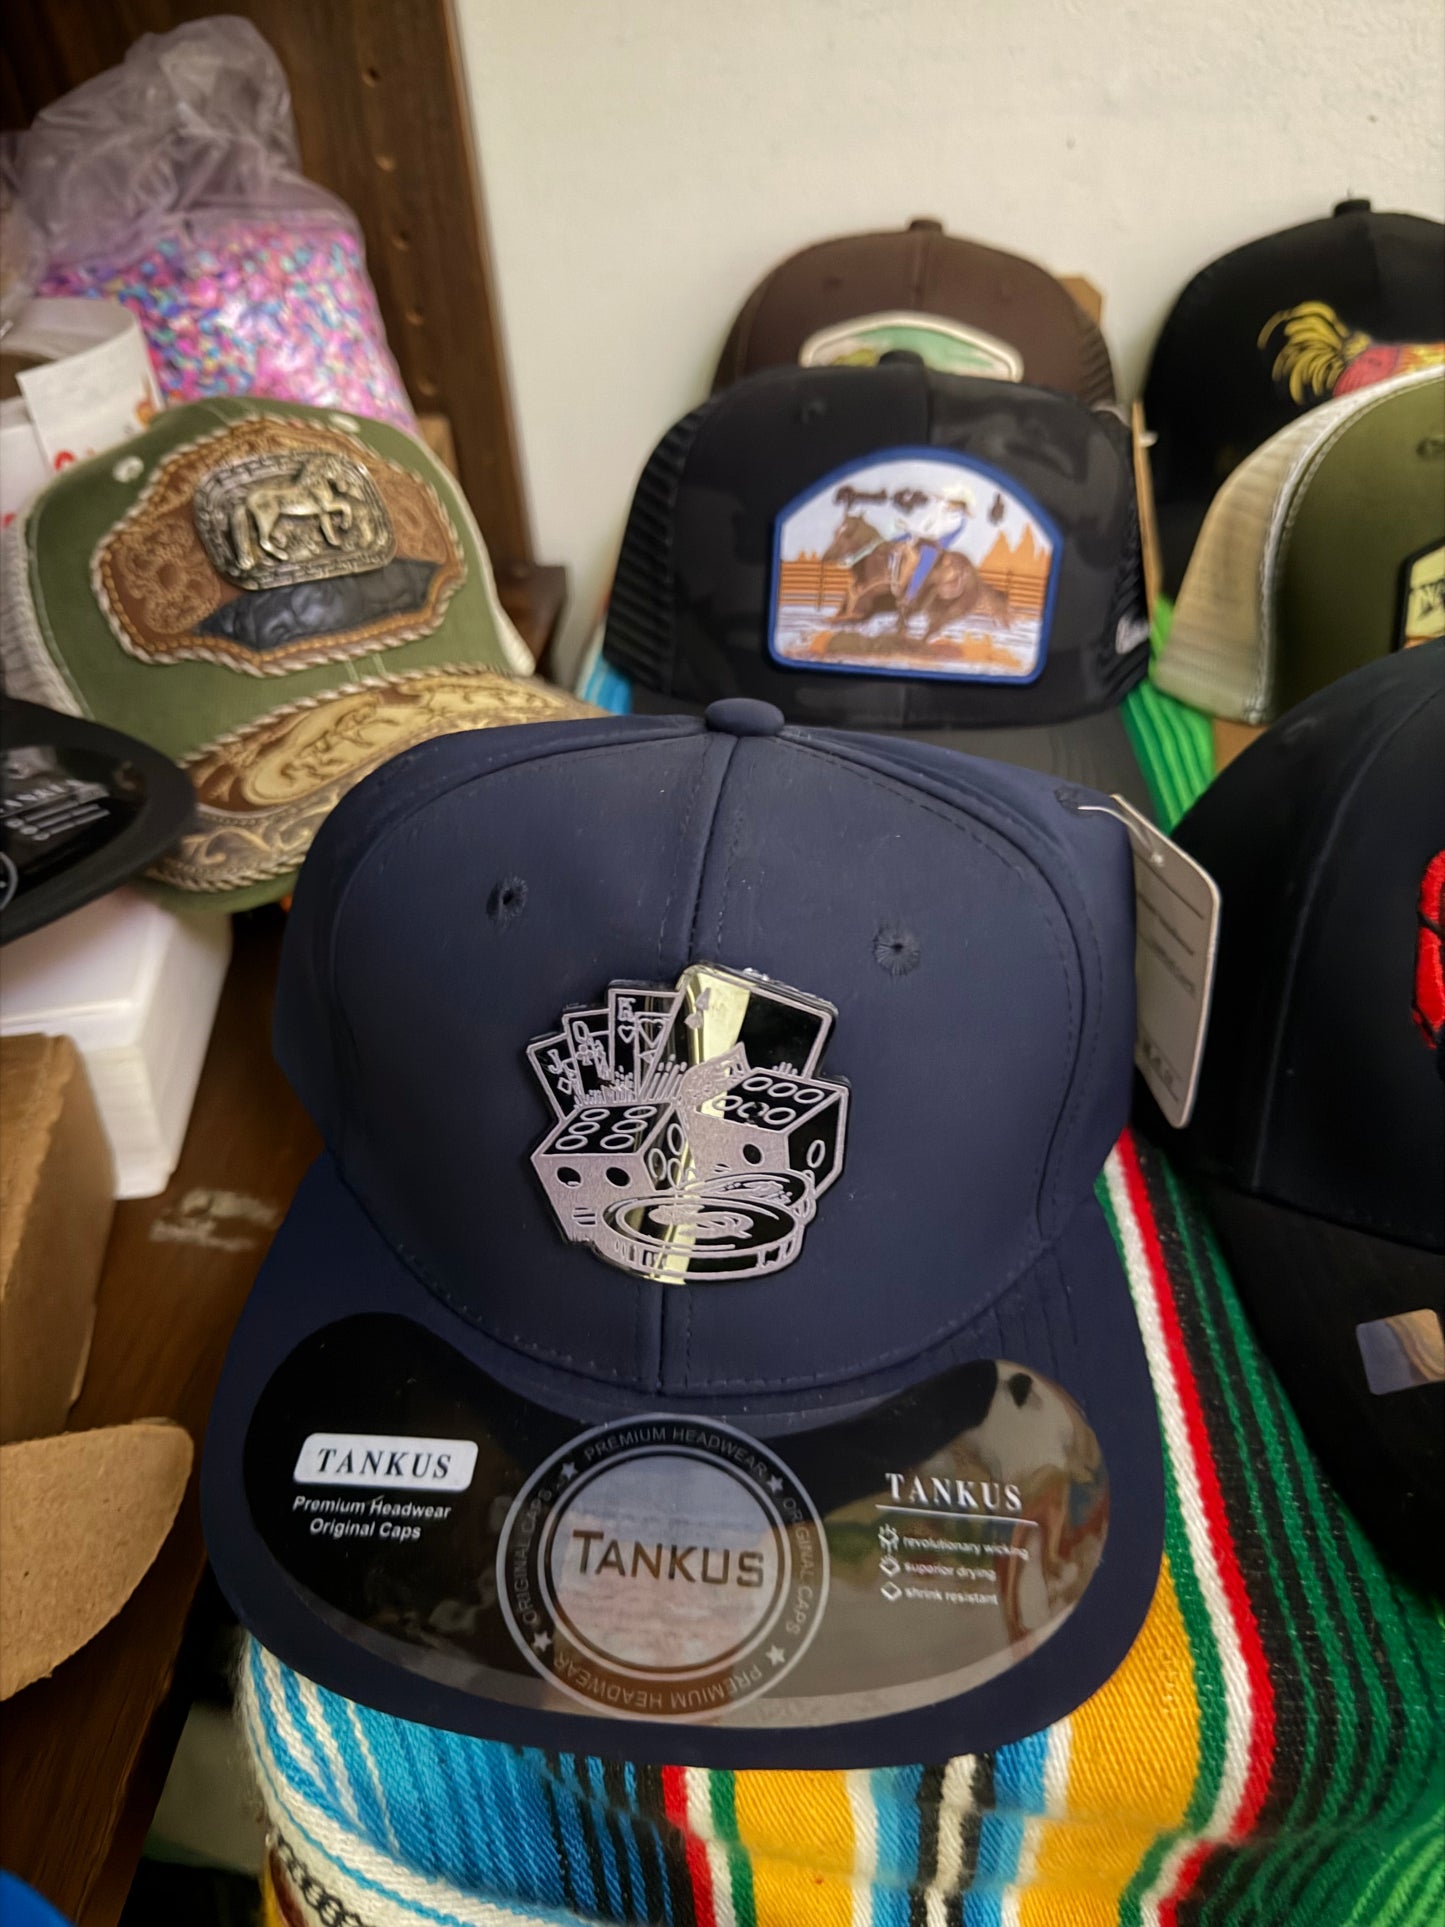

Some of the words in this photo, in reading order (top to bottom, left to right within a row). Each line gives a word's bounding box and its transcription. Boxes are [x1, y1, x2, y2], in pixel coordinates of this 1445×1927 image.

[317, 1448, 453, 1479] TANKUS
[583, 1426, 666, 1461] PREMIUM
[672, 1427, 768, 1477] HEADWEAR
[292, 1495, 365, 1514] Premium
[369, 1498, 452, 1519] Headwear
[885, 1472, 1023, 1513] TANKUS
[310, 1517, 375, 1539] Original
[379, 1520, 421, 1542] Caps
[572, 1529, 765, 1588] TANKUS
[786, 1585, 814, 1635] CAPS
[554, 1651, 661, 1709] HEADWEAR
[670, 1663, 763, 1709] PREMIUM
